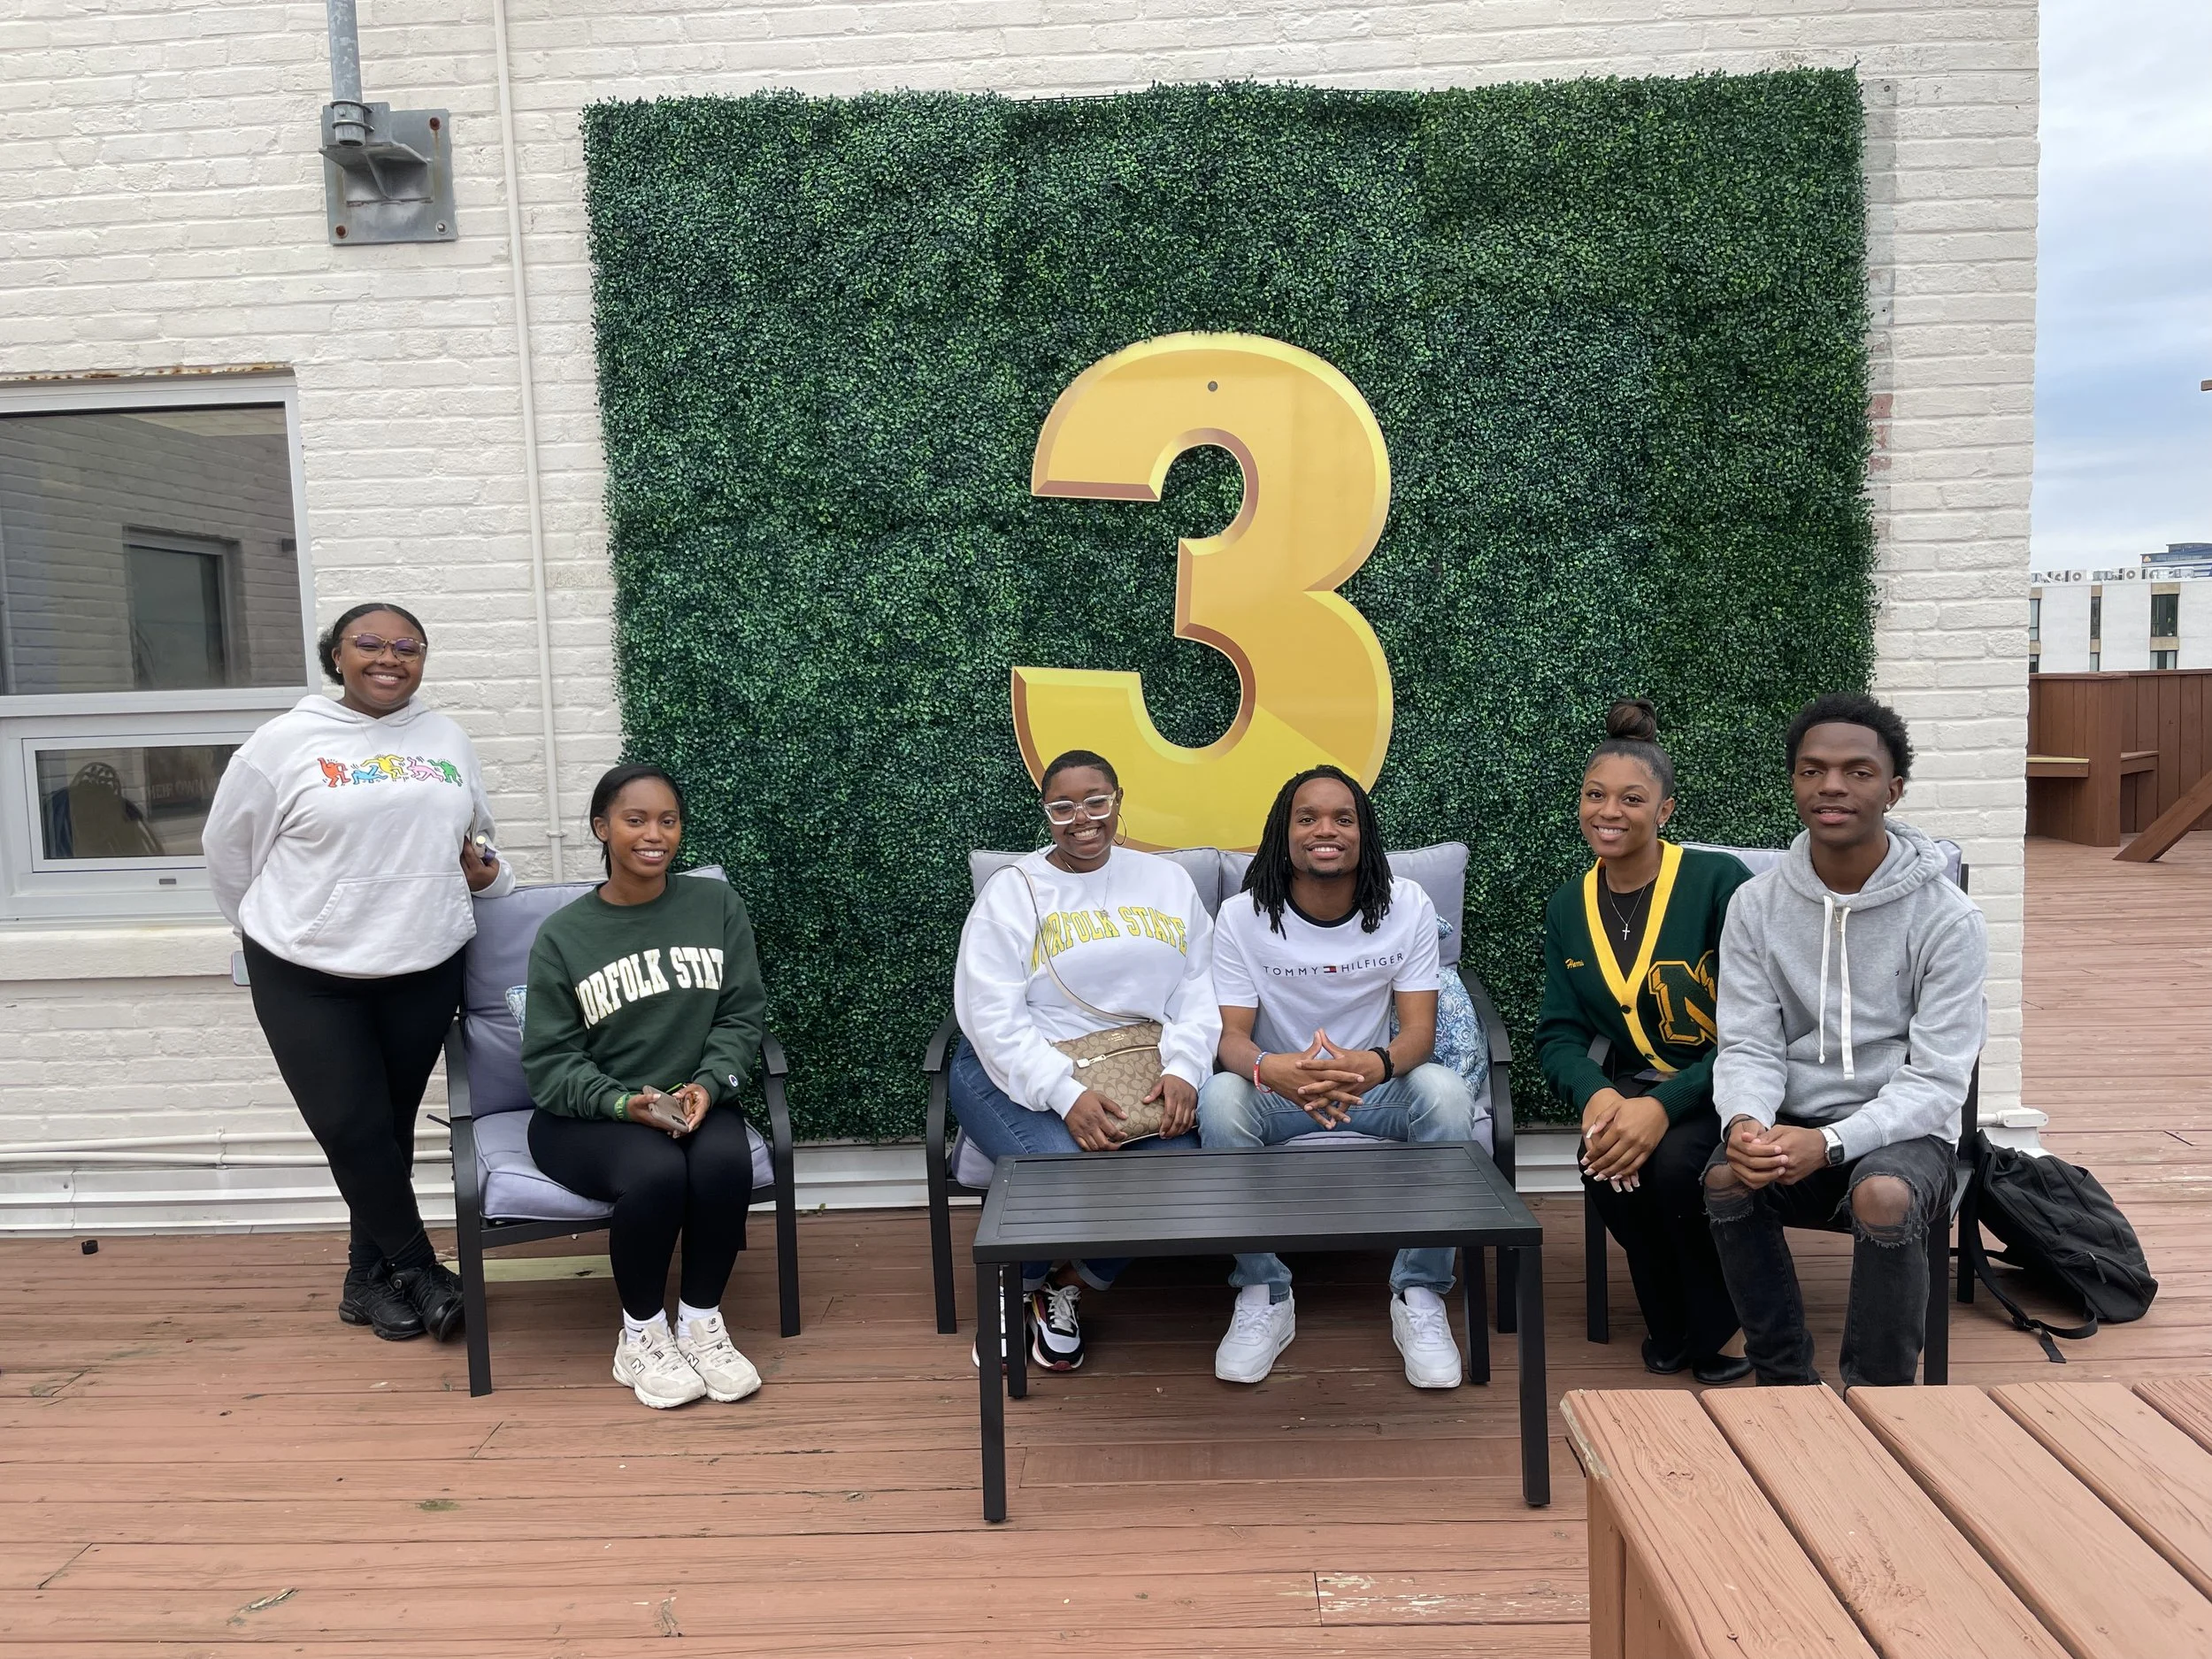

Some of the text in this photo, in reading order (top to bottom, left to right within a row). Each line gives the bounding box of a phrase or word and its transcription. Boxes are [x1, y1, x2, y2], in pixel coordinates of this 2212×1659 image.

[1010, 331, 1394, 854] 3
[1118, 906, 1187, 956] STATE
[670, 947, 724, 990] STAT
[1263, 952, 1403, 977] TOMMY HILFIGER
[630, 1357, 646, 1376] N
[686, 1352, 700, 1369] N
